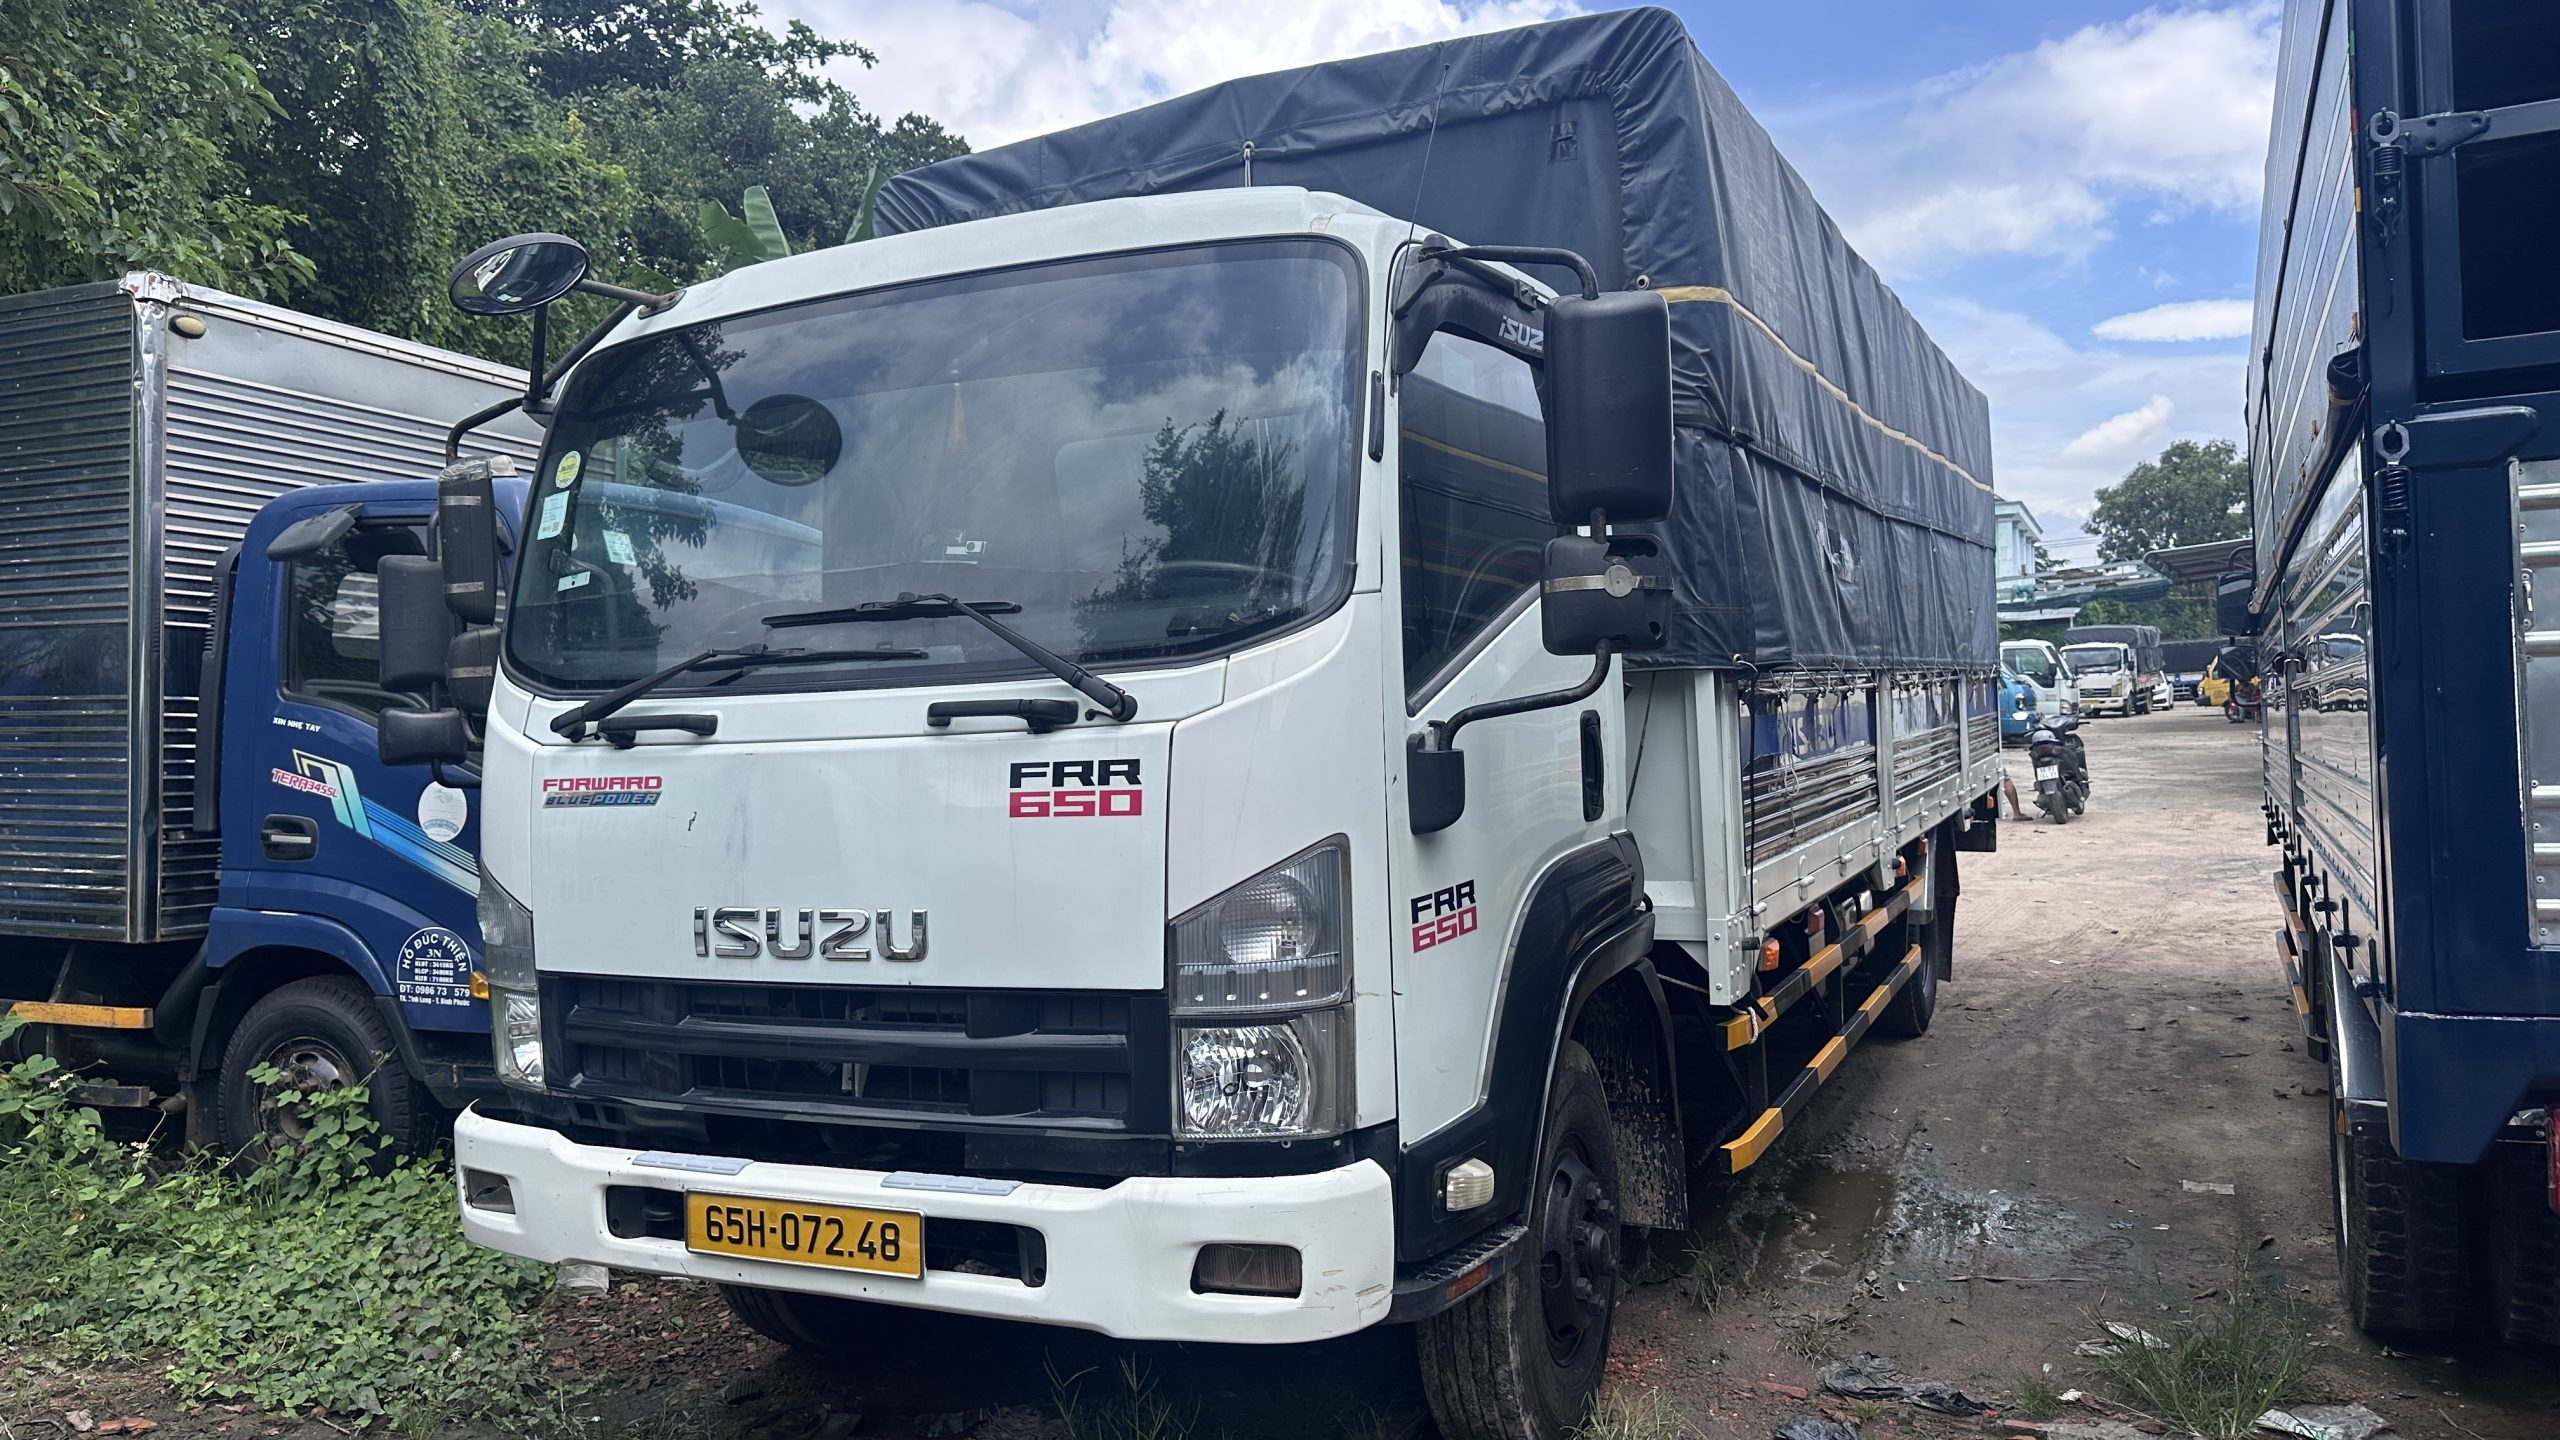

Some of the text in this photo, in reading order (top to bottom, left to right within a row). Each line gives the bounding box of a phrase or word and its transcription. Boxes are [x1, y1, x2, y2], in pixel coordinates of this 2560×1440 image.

[1499, 315, 1544, 351] iSUZ
[272, 716, 286, 726] XIN
[305, 722, 321, 733] TAY
[543, 776, 663, 792] FORWARD
[1010, 759, 1142, 788] FRR
[1009, 790, 1142, 817] 650
[1411, 879, 1476, 924] FRR
[694, 906, 929, 962] ISUZU
[1412, 906, 1478, 954] 650
[415, 986, 435, 995] 0986
[454, 988, 470, 997] 579
[706, 1204, 900, 1262] 65H-072.48
